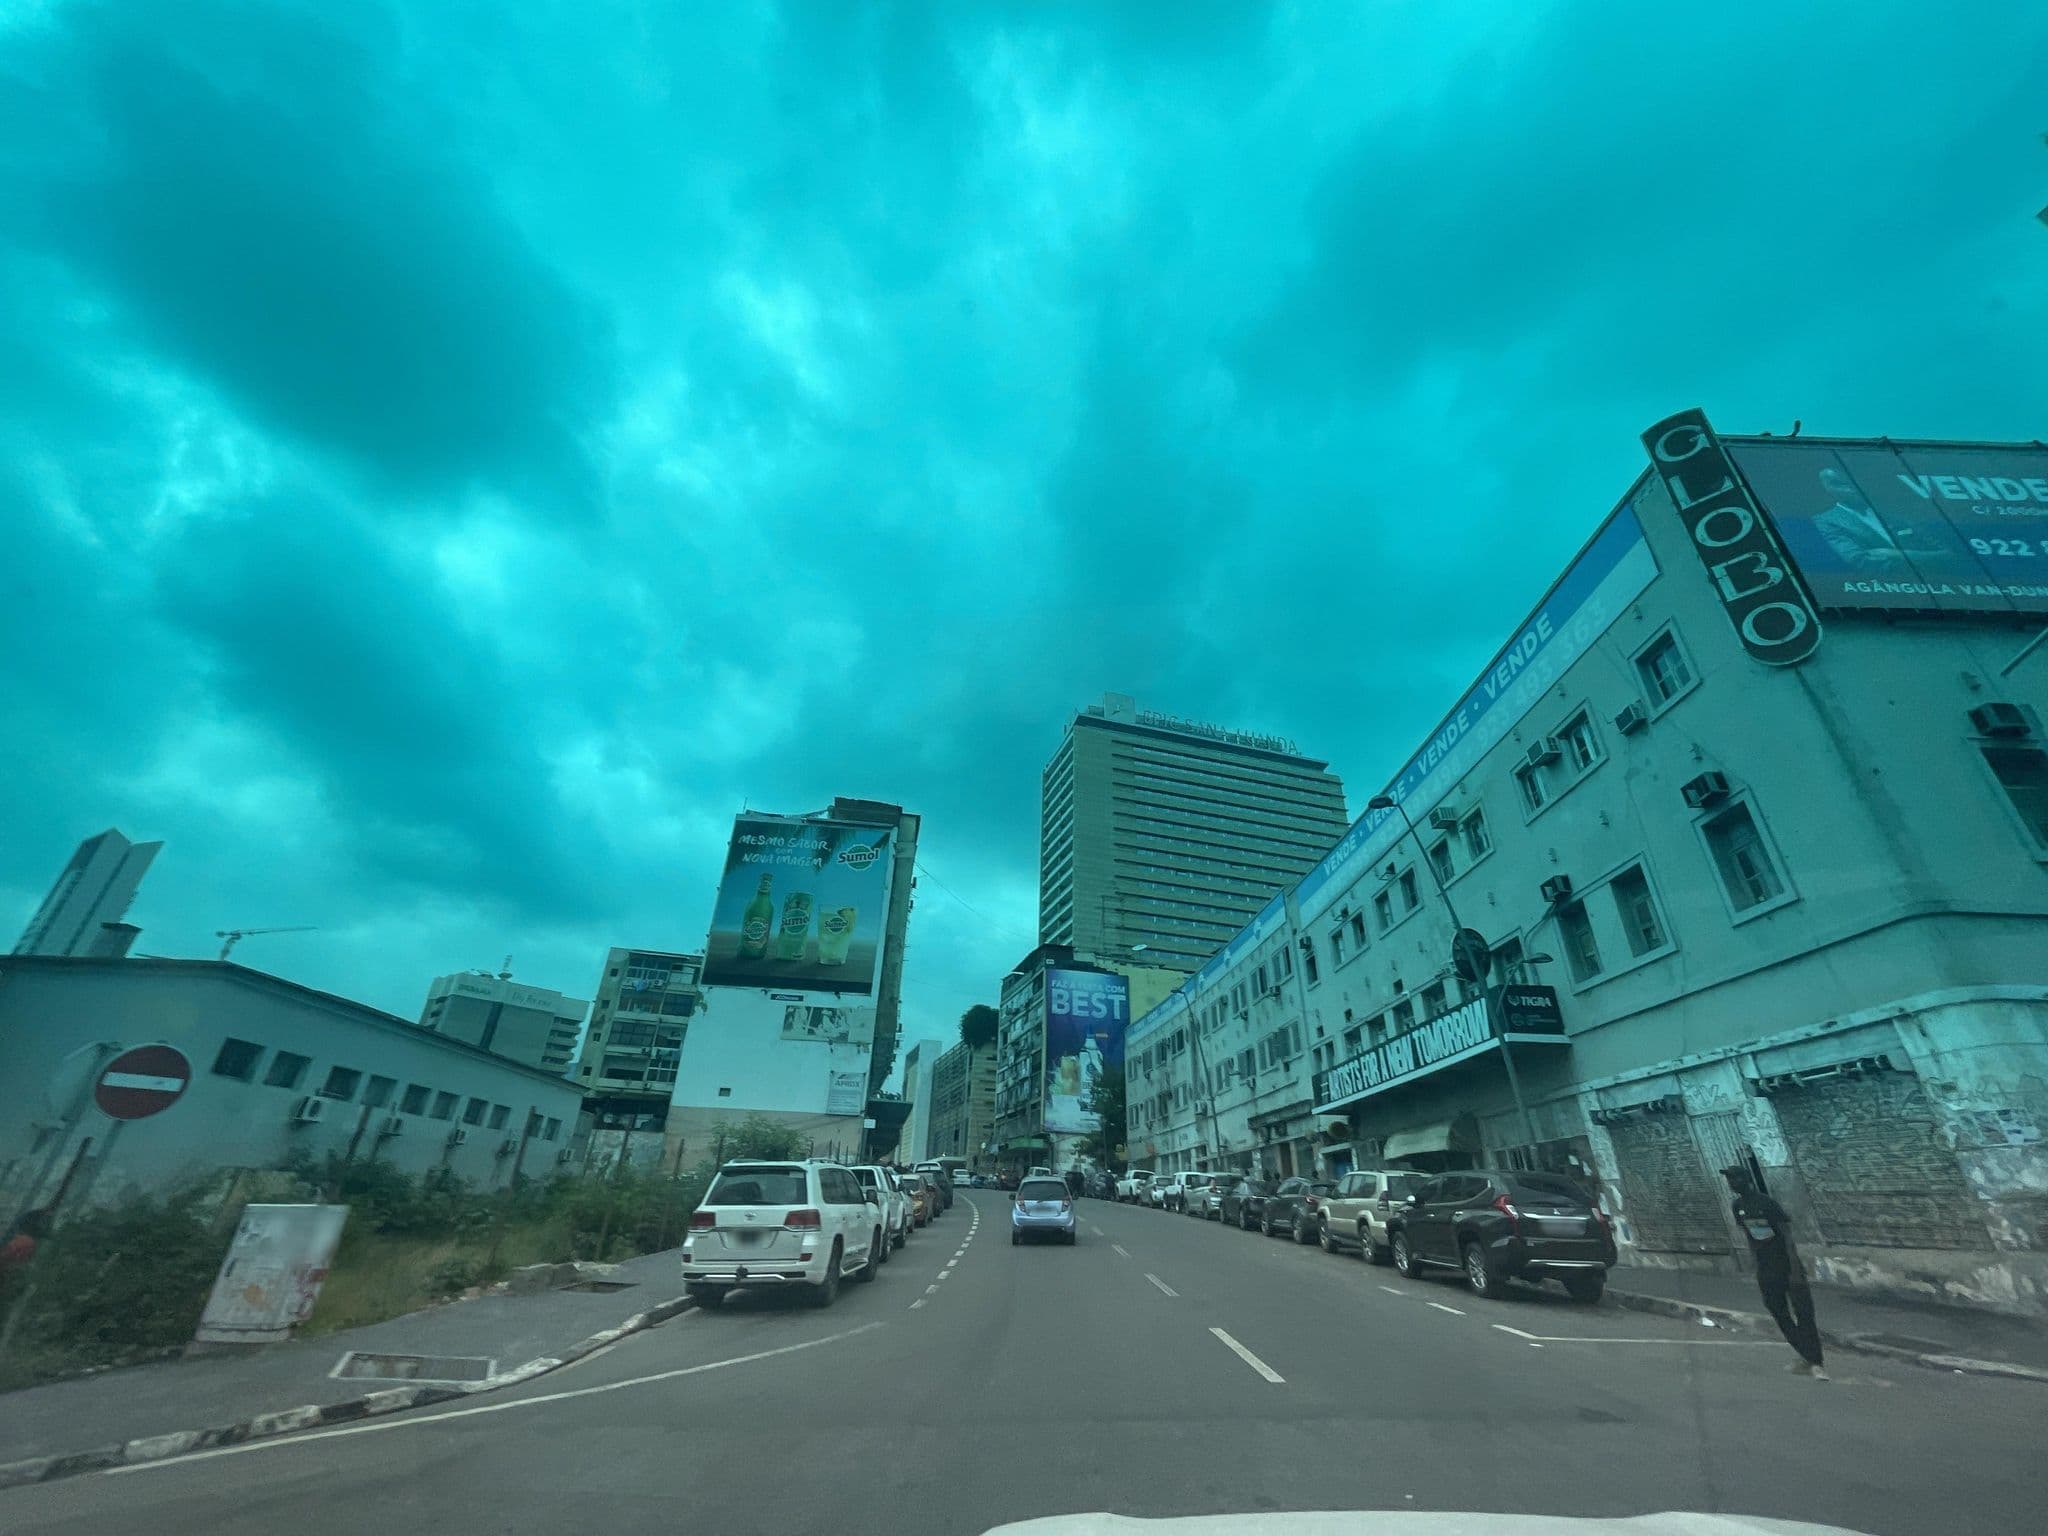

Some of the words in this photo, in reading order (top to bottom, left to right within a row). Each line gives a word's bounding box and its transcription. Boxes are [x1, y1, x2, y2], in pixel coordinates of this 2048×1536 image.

[1655, 425, 1808, 646] GLOBO
[1970, 538, 2036, 556] 922
[1323, 834, 1357, 876] VENDE
[1418, 710, 1470, 775] VENDE
[1484, 612, 1553, 699] VENDE
[738, 834, 785, 847] MESMO
[837, 848, 881, 864] Sumol
[1105, 984, 1126, 994] COM
[1051, 988, 1126, 1020] BEST
[1328, 1057, 1363, 1101] ARTISTS
[1361, 1050, 1381, 1088] FOR
[1385, 1034, 1415, 1078] NEW
[1412, 997, 1491, 1066] TOMORROW
